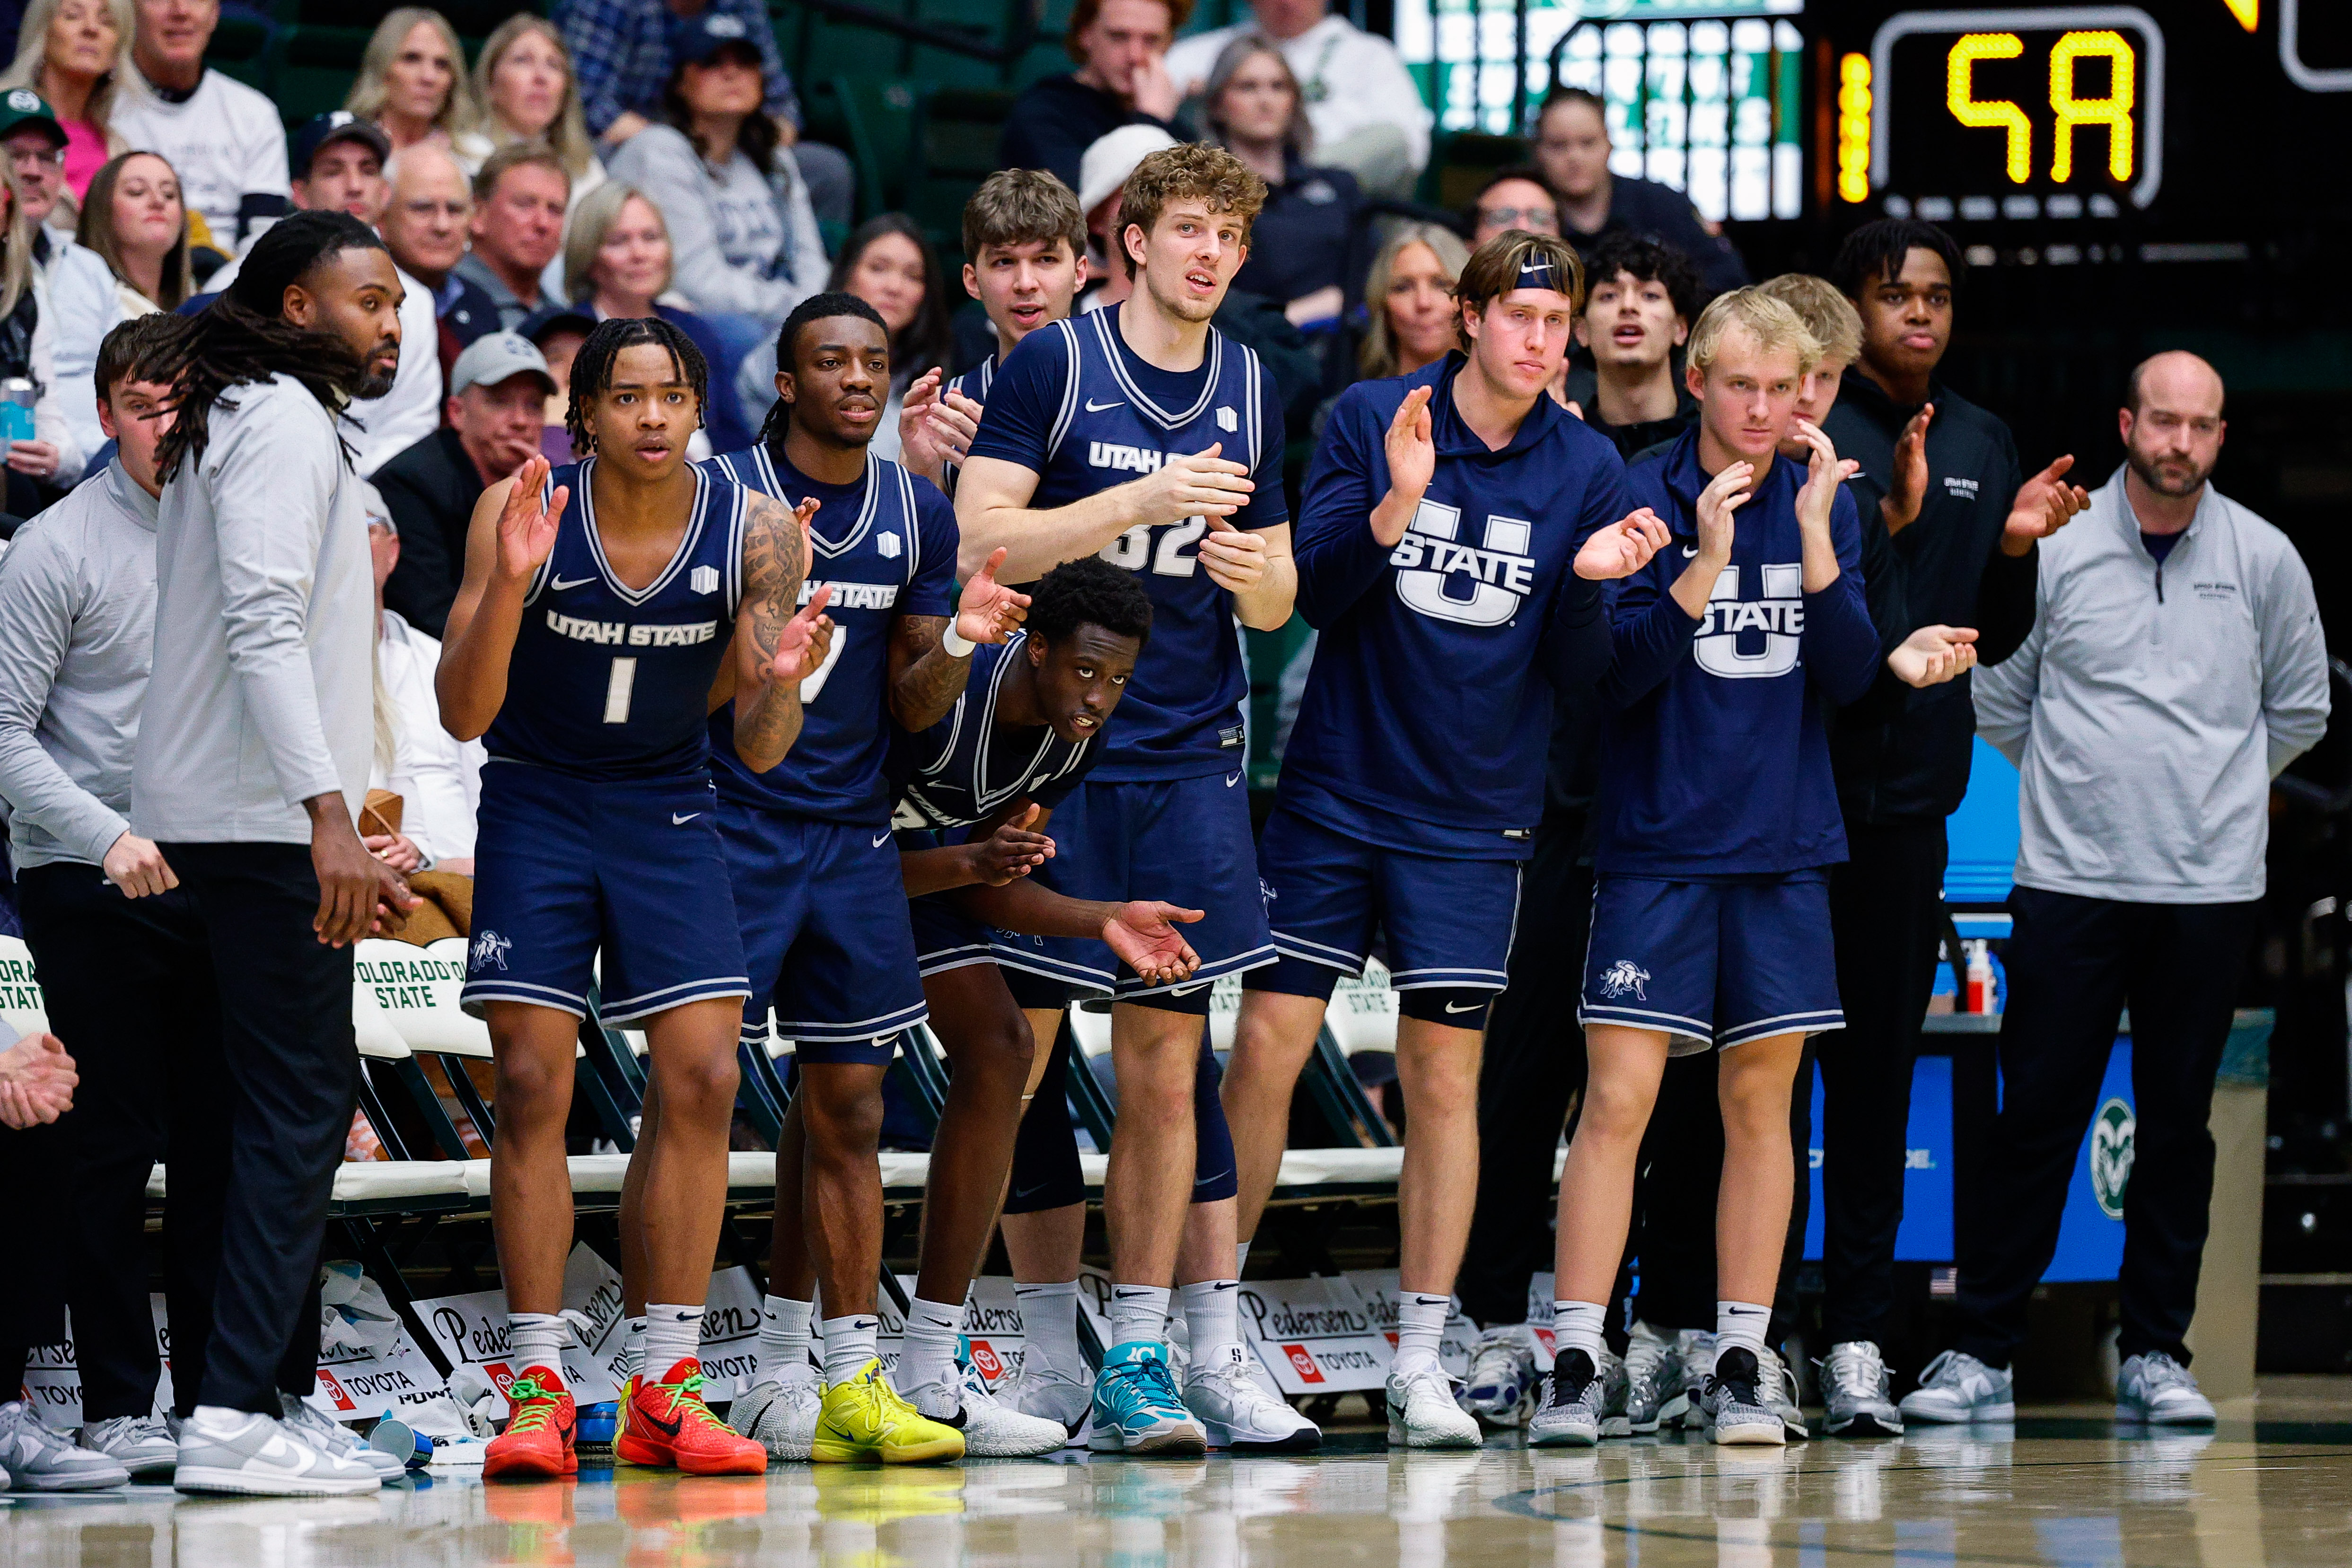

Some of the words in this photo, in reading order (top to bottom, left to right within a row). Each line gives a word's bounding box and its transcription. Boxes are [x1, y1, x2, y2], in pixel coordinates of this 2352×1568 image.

[1089, 441, 1162, 473] UTAH
[1389, 532, 1536, 596] STATE
[546, 609, 625, 646] UTAH
[628, 620, 718, 647] STATE
[603, 657, 637, 724] 1
[355, 961, 451, 983] OLORADO
[375, 986, 437, 1008] STATE
[1237, 1290, 1369, 1341] Pedersen
[700, 1354, 757, 1380] OYOTA
[1315, 1351, 1381, 1371] TOYOTA
[342, 1371, 416, 1396] TOYOTA
